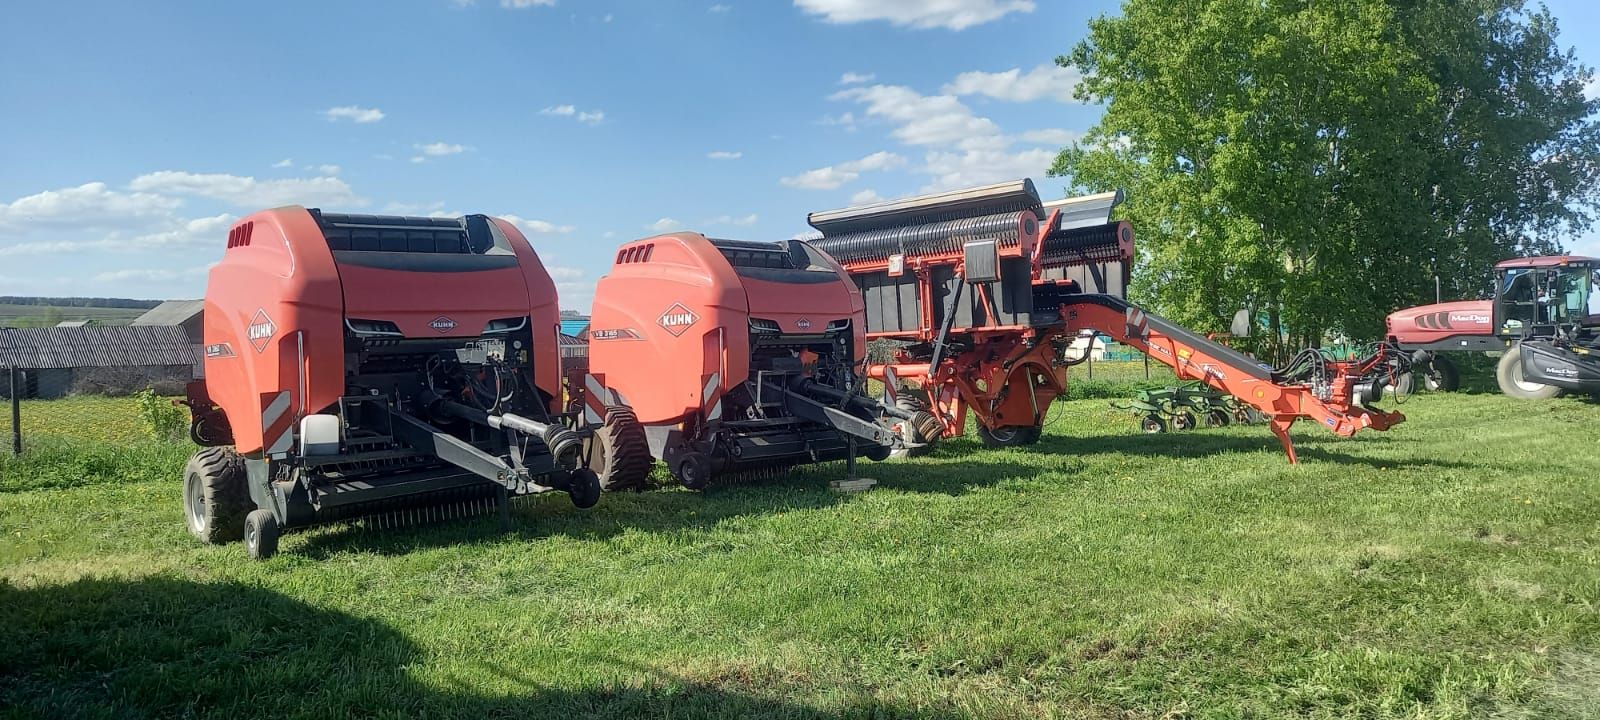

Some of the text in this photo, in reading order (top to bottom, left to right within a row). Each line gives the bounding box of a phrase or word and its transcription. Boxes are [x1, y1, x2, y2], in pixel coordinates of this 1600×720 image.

[662, 313, 692, 326] KUHN
[1451, 314, 1489, 322] MacDon
[250, 322, 272, 340] KUHN
